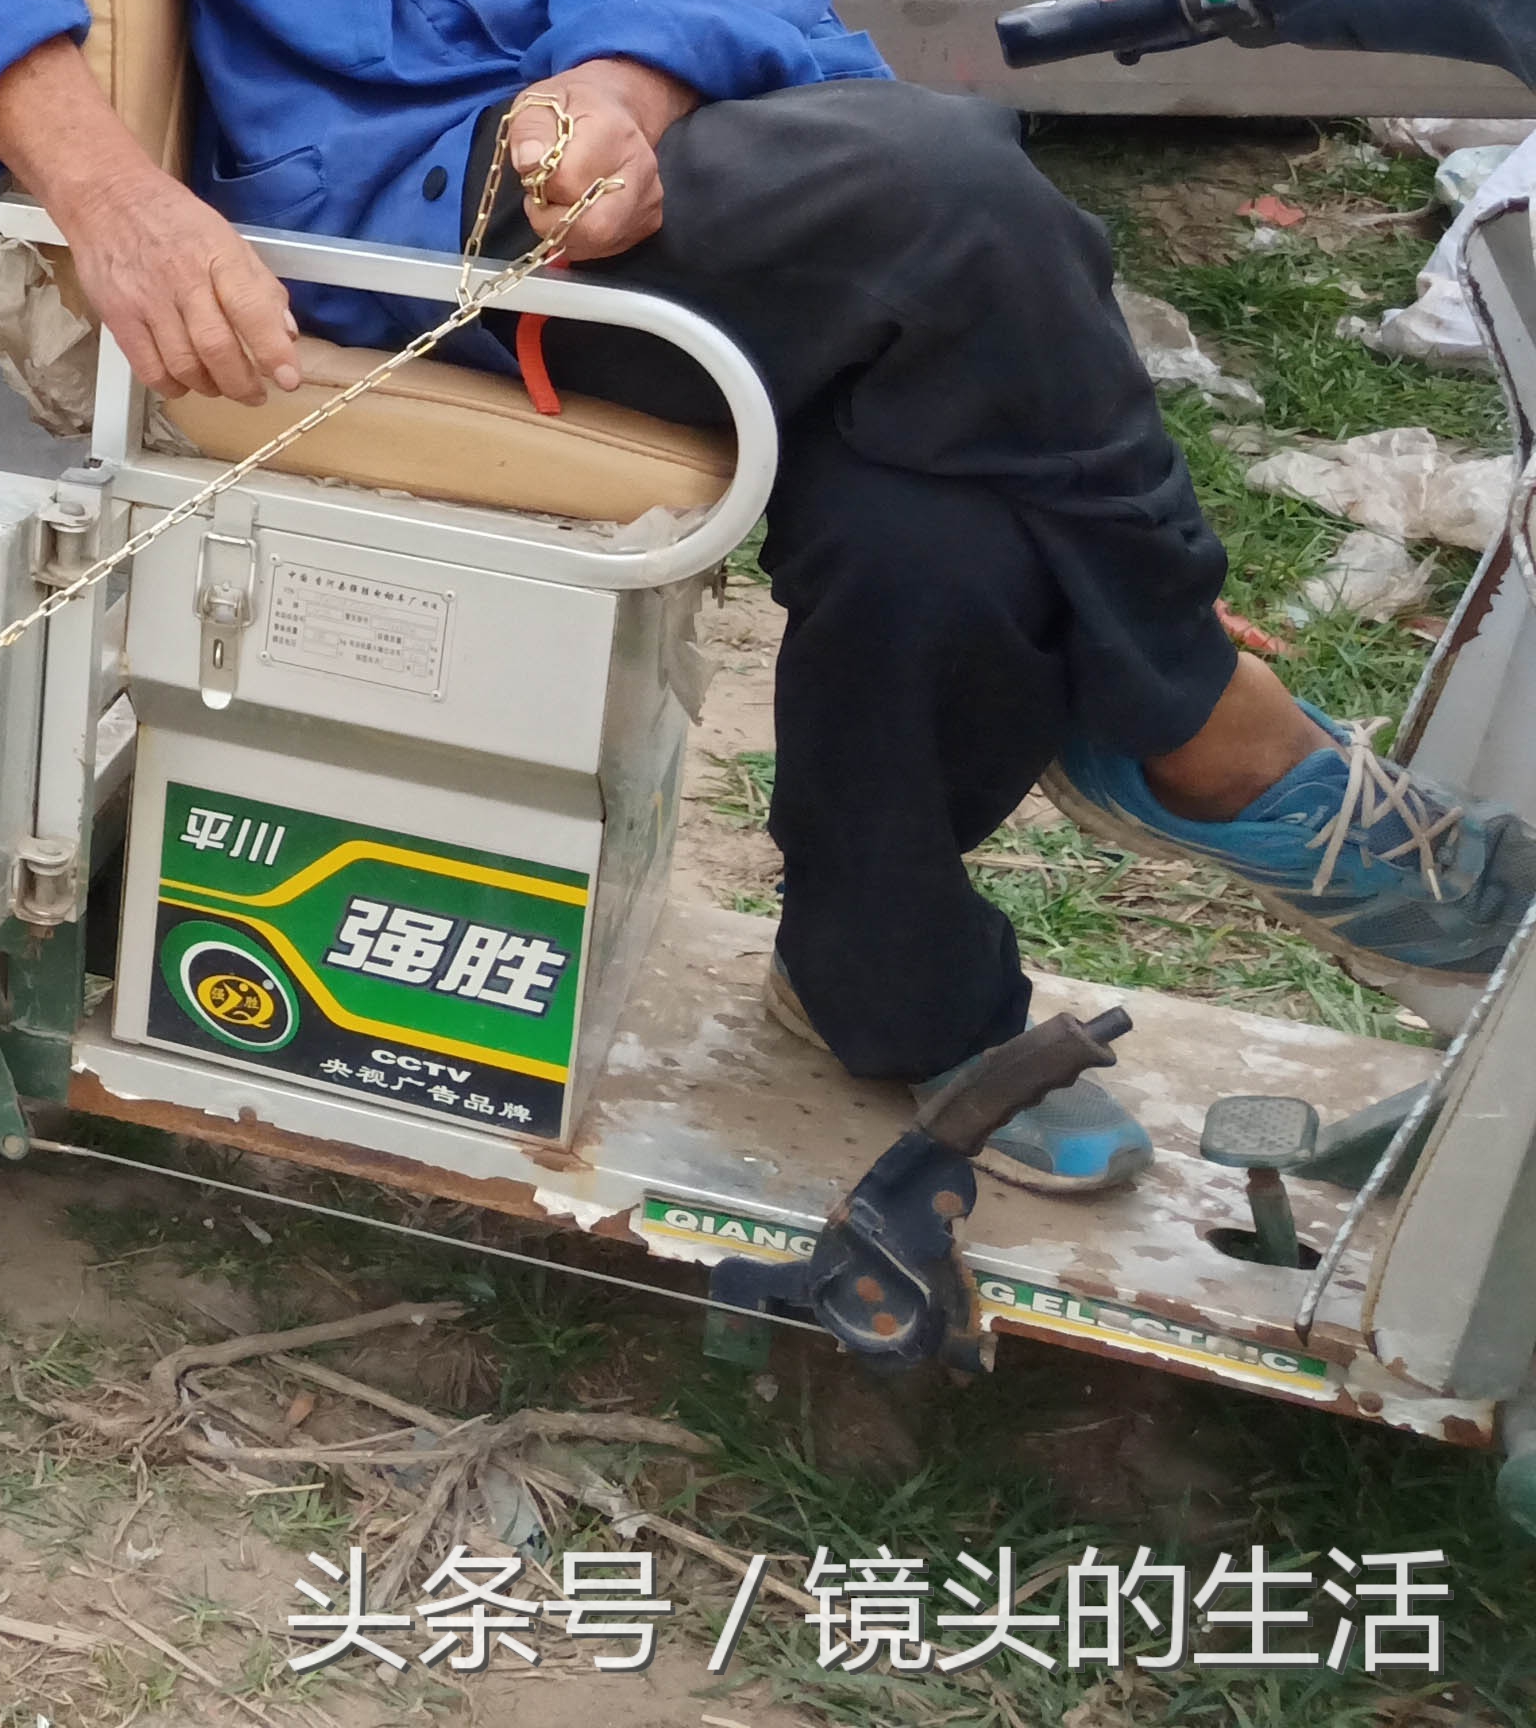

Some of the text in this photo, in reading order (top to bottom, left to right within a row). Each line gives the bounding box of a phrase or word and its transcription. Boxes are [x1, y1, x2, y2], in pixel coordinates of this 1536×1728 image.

[180, 806, 286, 866] 平川
[326, 897, 569, 1015] 强胜
[319, 1057, 533, 1124] 央视广告品牌
[371, 1048, 472, 1083] CCTV
[664, 1208, 817, 1258] QIANG
